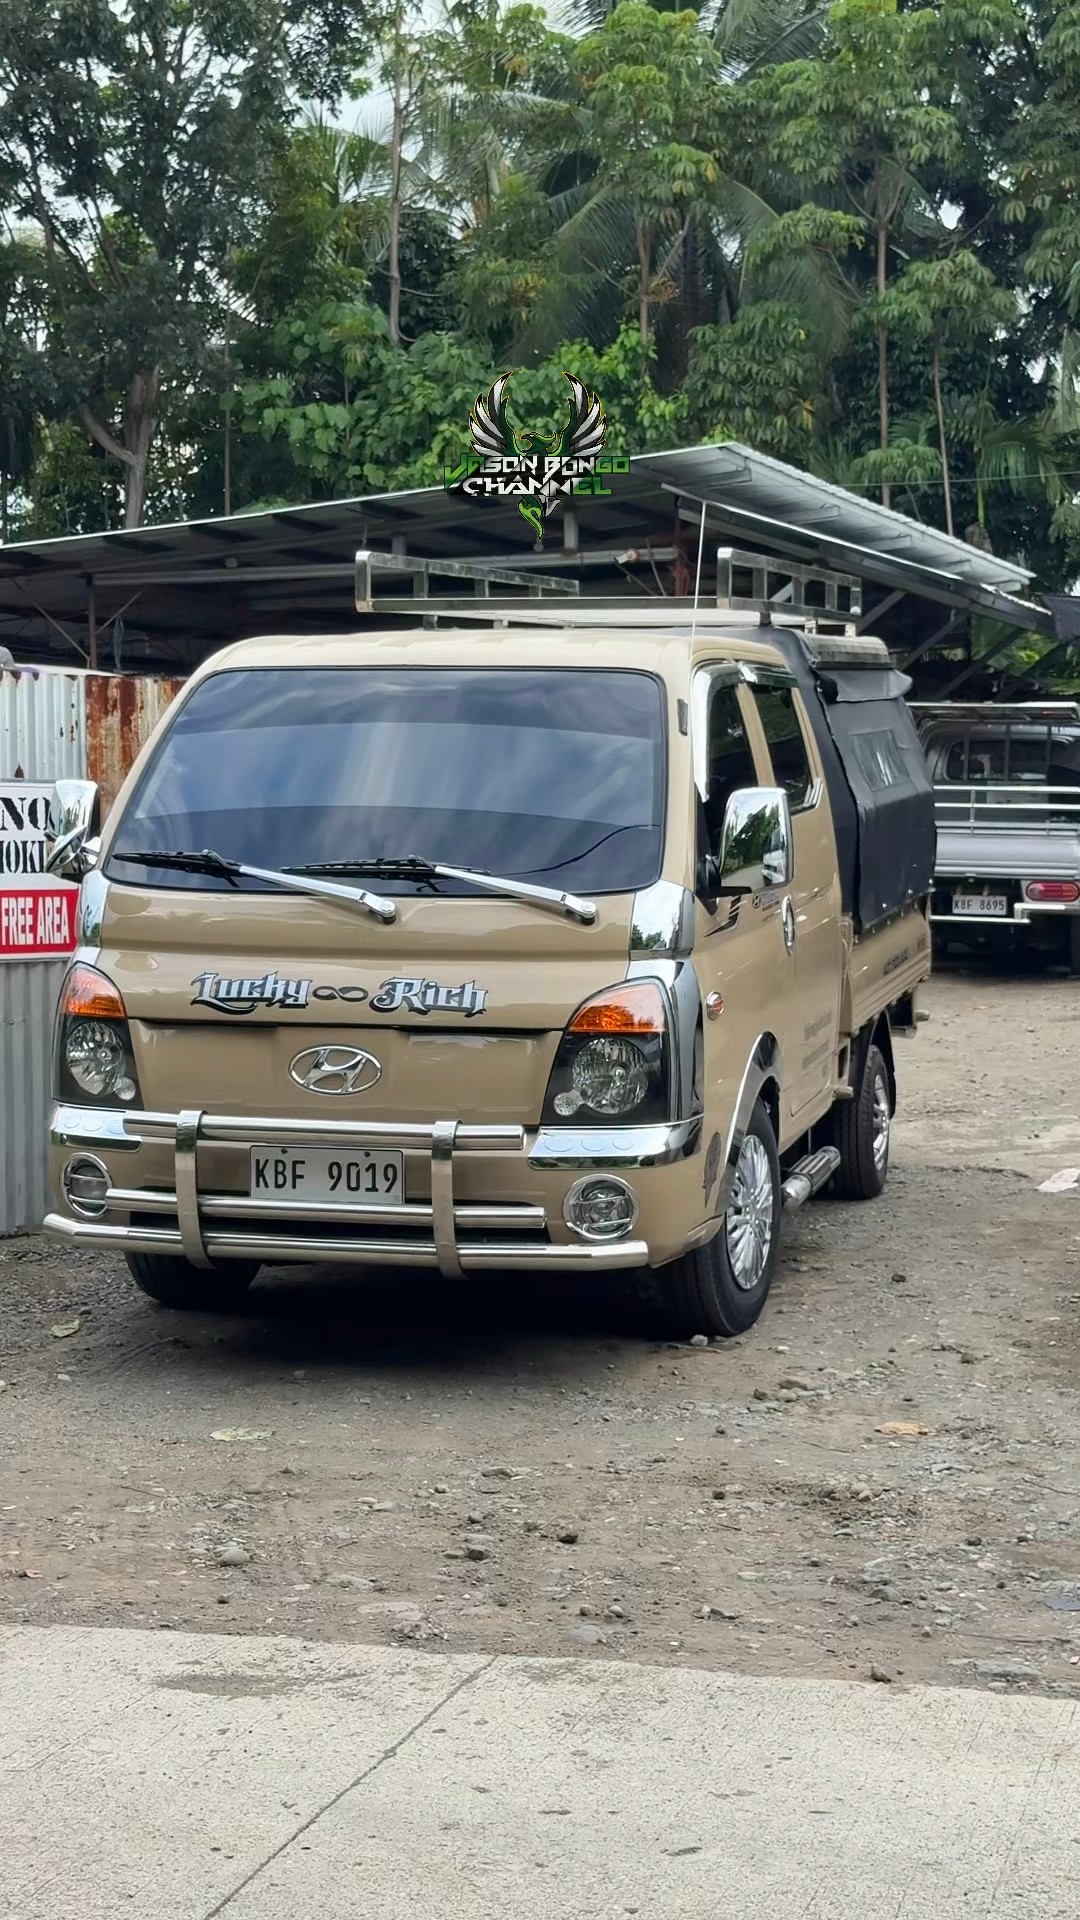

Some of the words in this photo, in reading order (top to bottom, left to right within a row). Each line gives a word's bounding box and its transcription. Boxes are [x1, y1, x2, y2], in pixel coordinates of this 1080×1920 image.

[2, 897, 34, 945] FREE
[36, 896, 70, 944] AREA
[190, 971, 312, 1015] Lucky
[369, 976, 488, 1018] Rich
[255, 1158, 306, 1190] KBF
[327, 1161, 398, 1193] 9019
